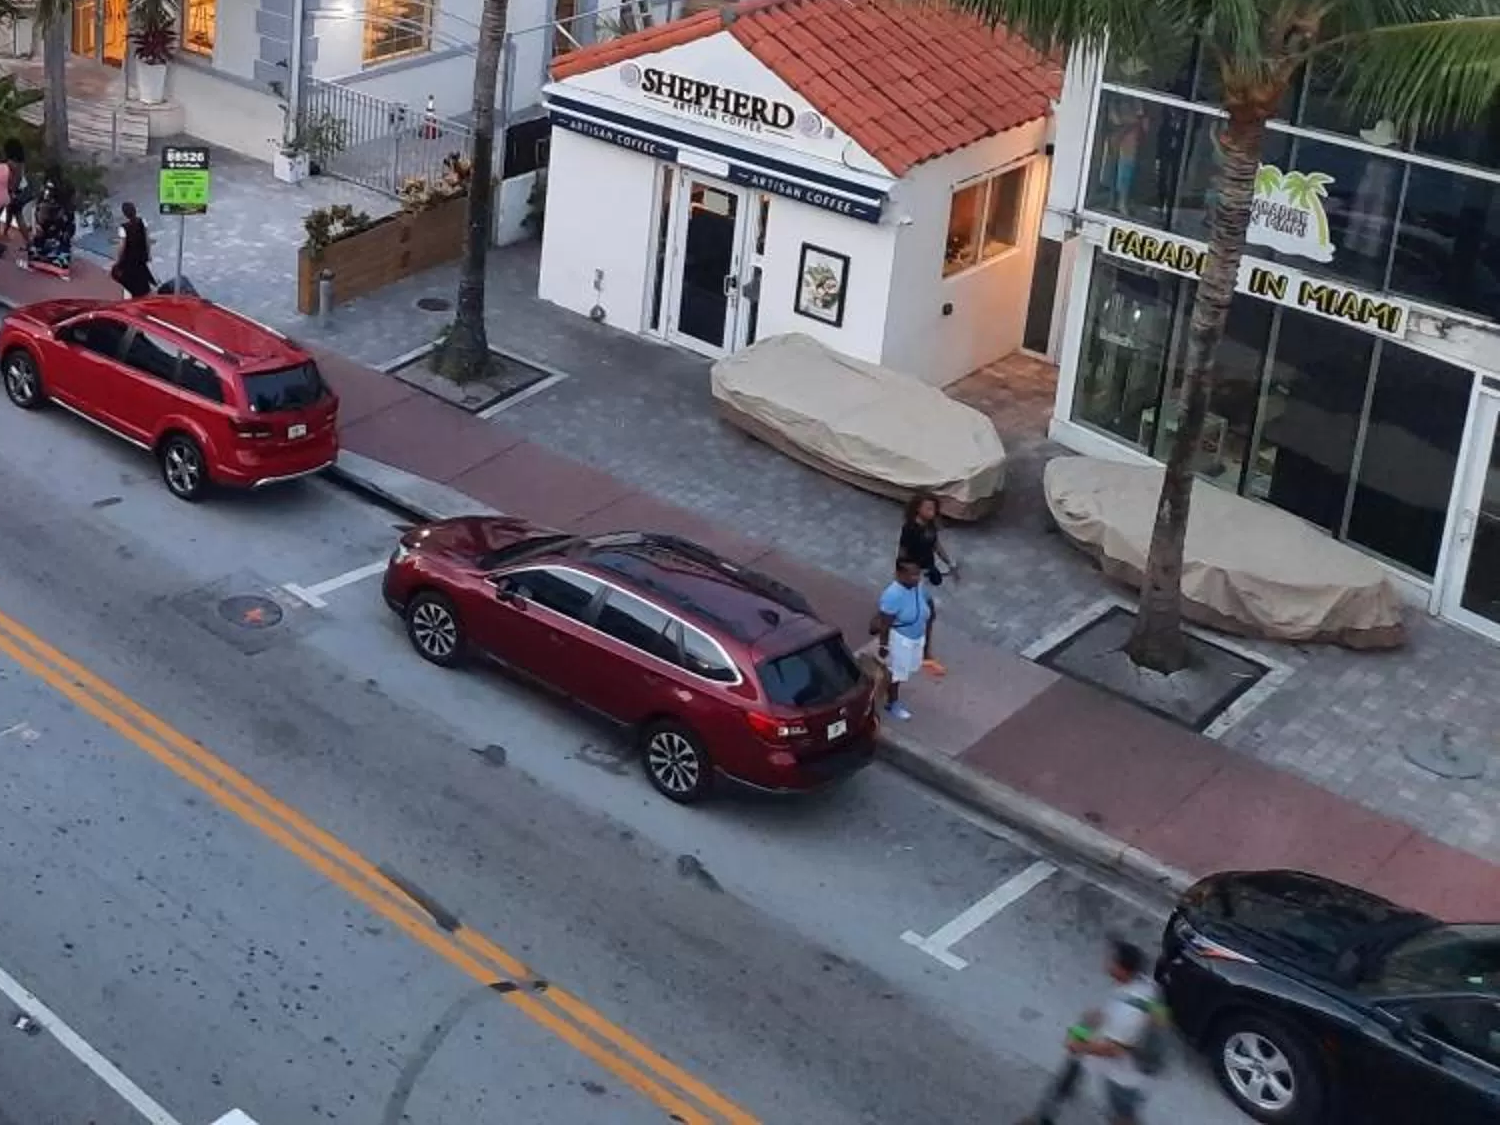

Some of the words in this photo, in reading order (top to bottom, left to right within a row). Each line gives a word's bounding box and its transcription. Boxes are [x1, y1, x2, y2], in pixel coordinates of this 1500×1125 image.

[641, 68, 796, 130] SHEPHERD
[672, 101, 717, 123] ARTISAN
[721, 113, 763, 134] COFFEE
[569, 119, 613, 141] ARTISAN
[616, 134, 656, 154] COFFEE
[751, 174, 802, 197] ARTISAN
[805, 191, 852, 213] COFFEE
[1109, 227, 1211, 275] PARADI
[1250, 267, 1289, 301] IN
[1298, 280, 1405, 332] MIAMI
